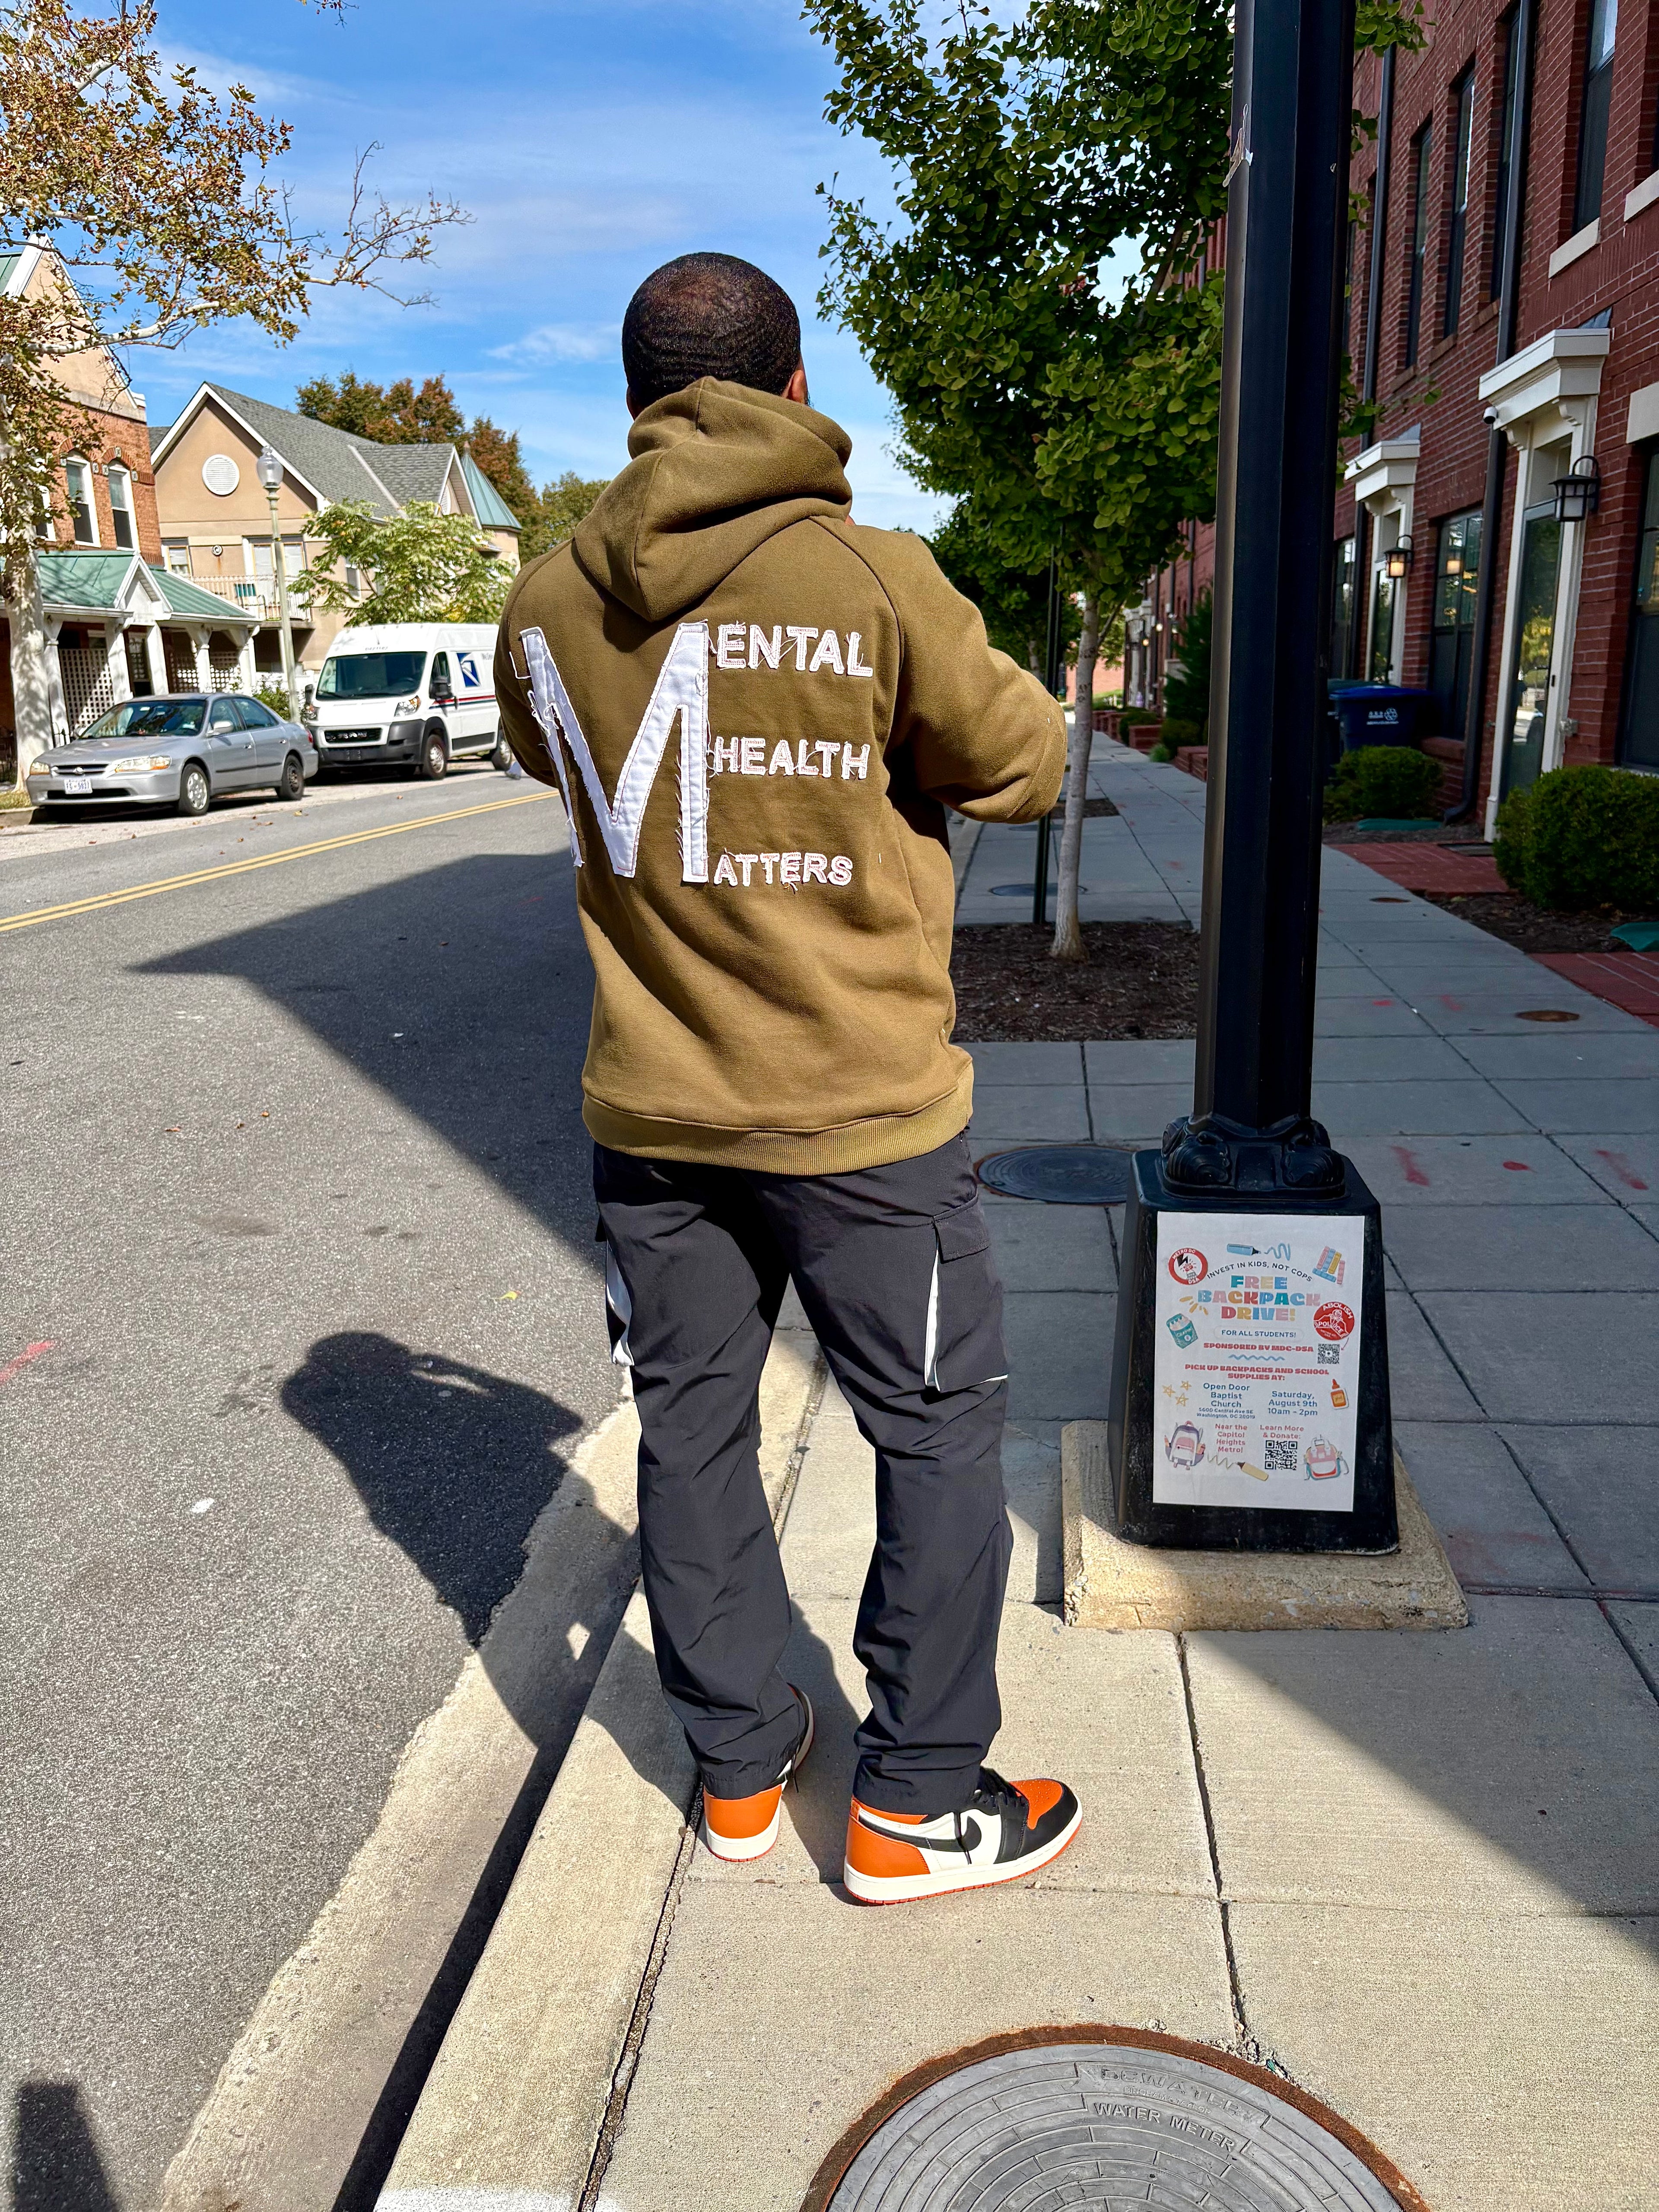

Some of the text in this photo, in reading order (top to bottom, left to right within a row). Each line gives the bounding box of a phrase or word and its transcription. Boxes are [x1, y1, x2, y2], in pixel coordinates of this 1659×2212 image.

[714, 736, 870, 779] HEALTH
[1207, 1264, 1234, 1279] INVEST
[1272, 1263, 1290, 1271] NOT
[1291, 1268, 1313, 1282] COPS
[1231, 1275, 1287, 1290] FREE
[1198, 1290, 1321, 1306] BACKPACK
[1221, 1306, 1296, 1321] DRIVE!
[1322, 1302, 1353, 1319] ABOLISH
[1203, 1382, 1226, 1391] Open
[1211, 1392, 1242, 1400] Baptist
[1272, 1391, 1314, 1400] Saturday,
[1268, 1399, 1300, 1408] August
[1124, 2087, 1166, 2102] BINGHAM
[1094, 2102, 1235, 2152] WATER METER
